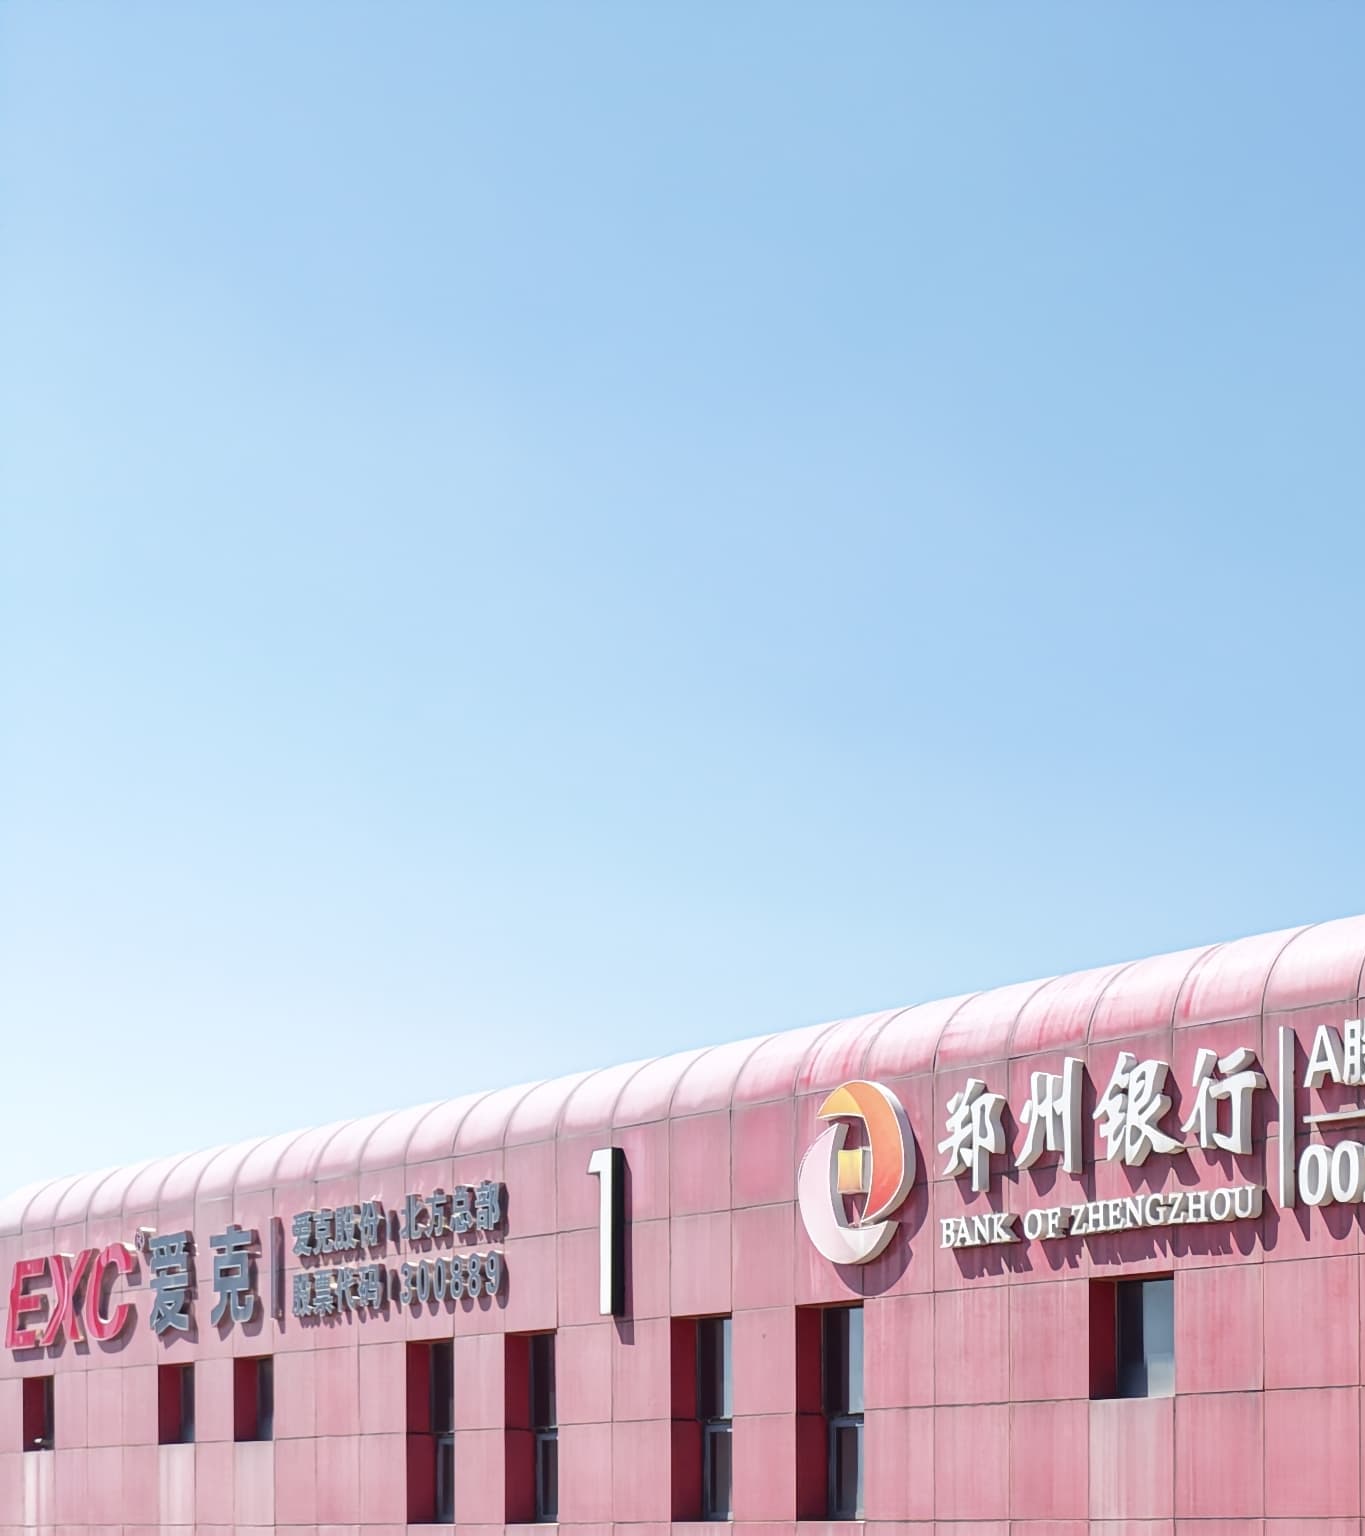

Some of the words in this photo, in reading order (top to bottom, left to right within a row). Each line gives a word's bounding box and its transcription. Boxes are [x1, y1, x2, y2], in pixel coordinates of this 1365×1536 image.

[937, 1047, 1266, 1192] 郑州银行
[293, 1200, 384, 1257] 爱克股份
[401, 1180, 504, 1241] 北方总部
[588, 1147, 624, 1316] 1
[940, 1211, 1020, 1248] BANK
[1023, 1207, 1071, 1240] OF
[1069, 1185, 1264, 1236] ZHENGZHOU
[149, 1226, 258, 1335] 爱克
[293, 1265, 384, 1318] 股票代码
[400, 1250, 502, 1305] 300889
